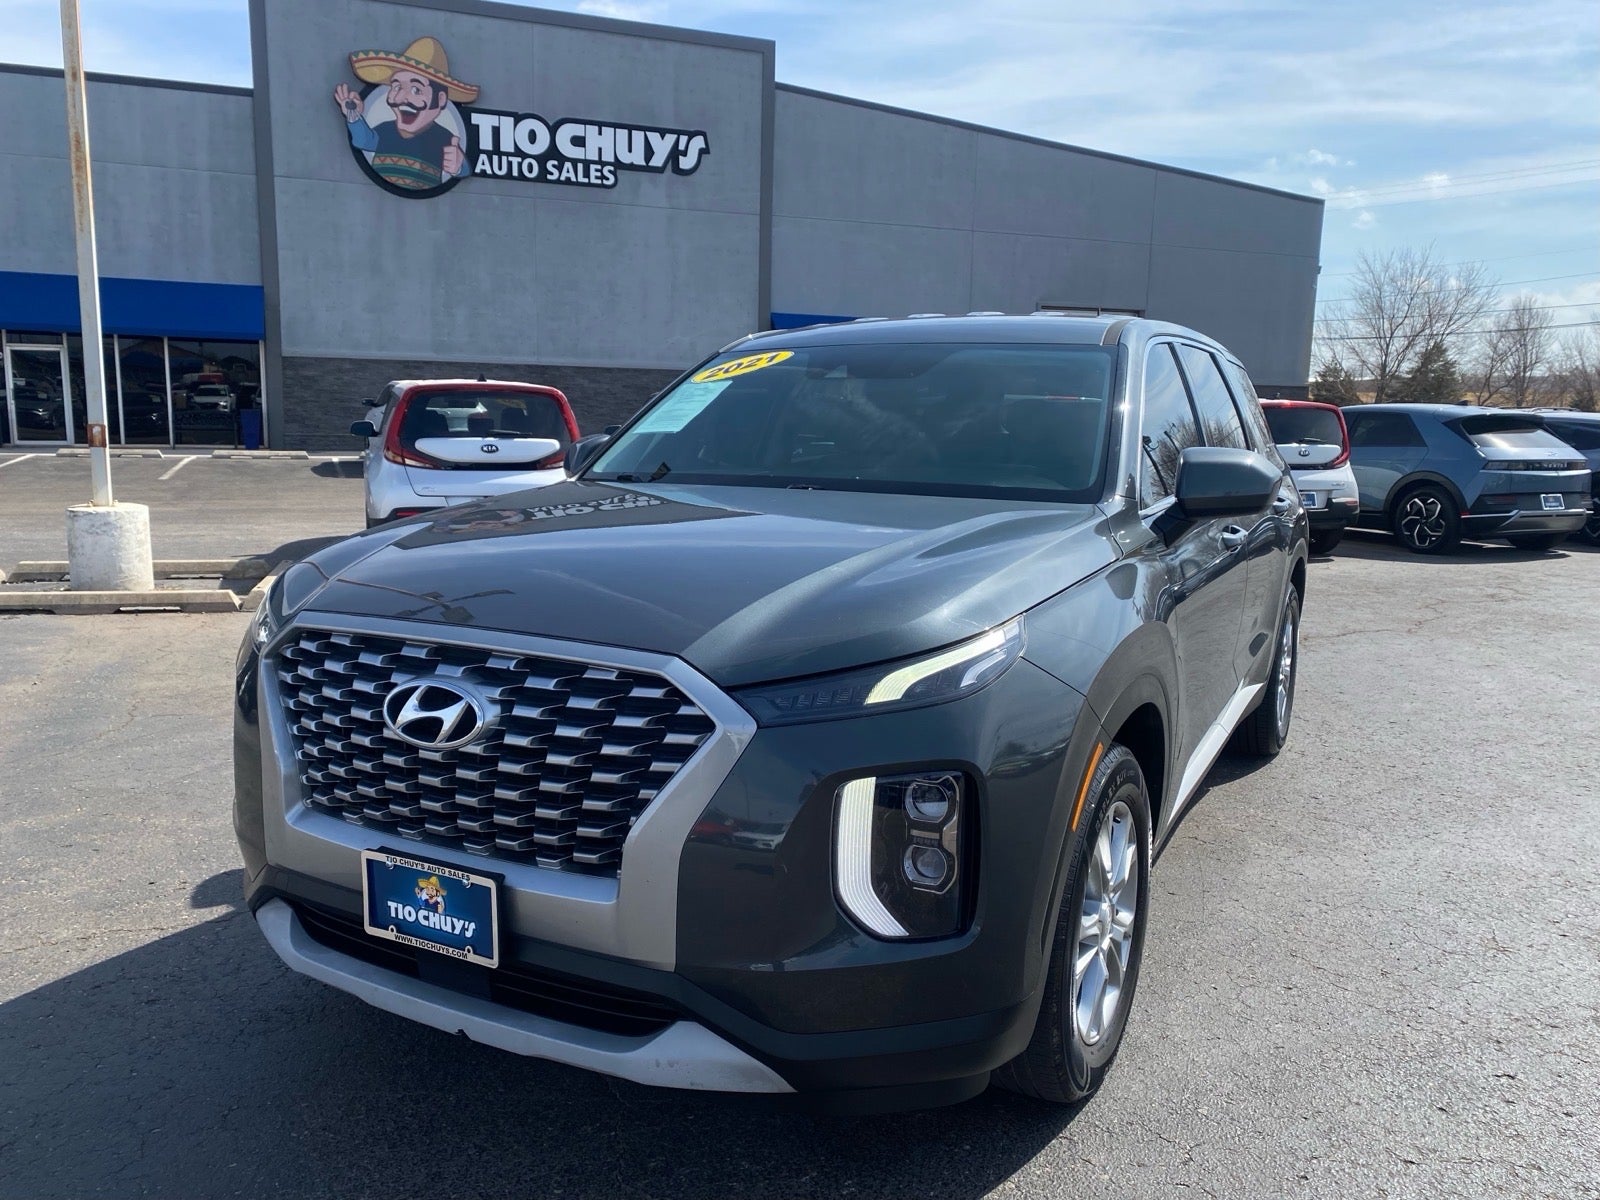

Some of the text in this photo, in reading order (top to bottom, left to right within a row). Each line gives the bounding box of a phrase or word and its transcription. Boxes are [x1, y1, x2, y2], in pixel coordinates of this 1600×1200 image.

[470, 112, 707, 170] TIO CHUY'S
[474, 153, 616, 186] AUTO SALES
[702, 353, 781, 380] 2021
[483, 445, 496, 453] KIA
[385, 855, 470, 881] TIO CHUY'S AUTO SALES
[387, 900, 476, 938] TIO CHUY'S
[394, 934, 468, 959] WWW.TIOCHUYS.COM
